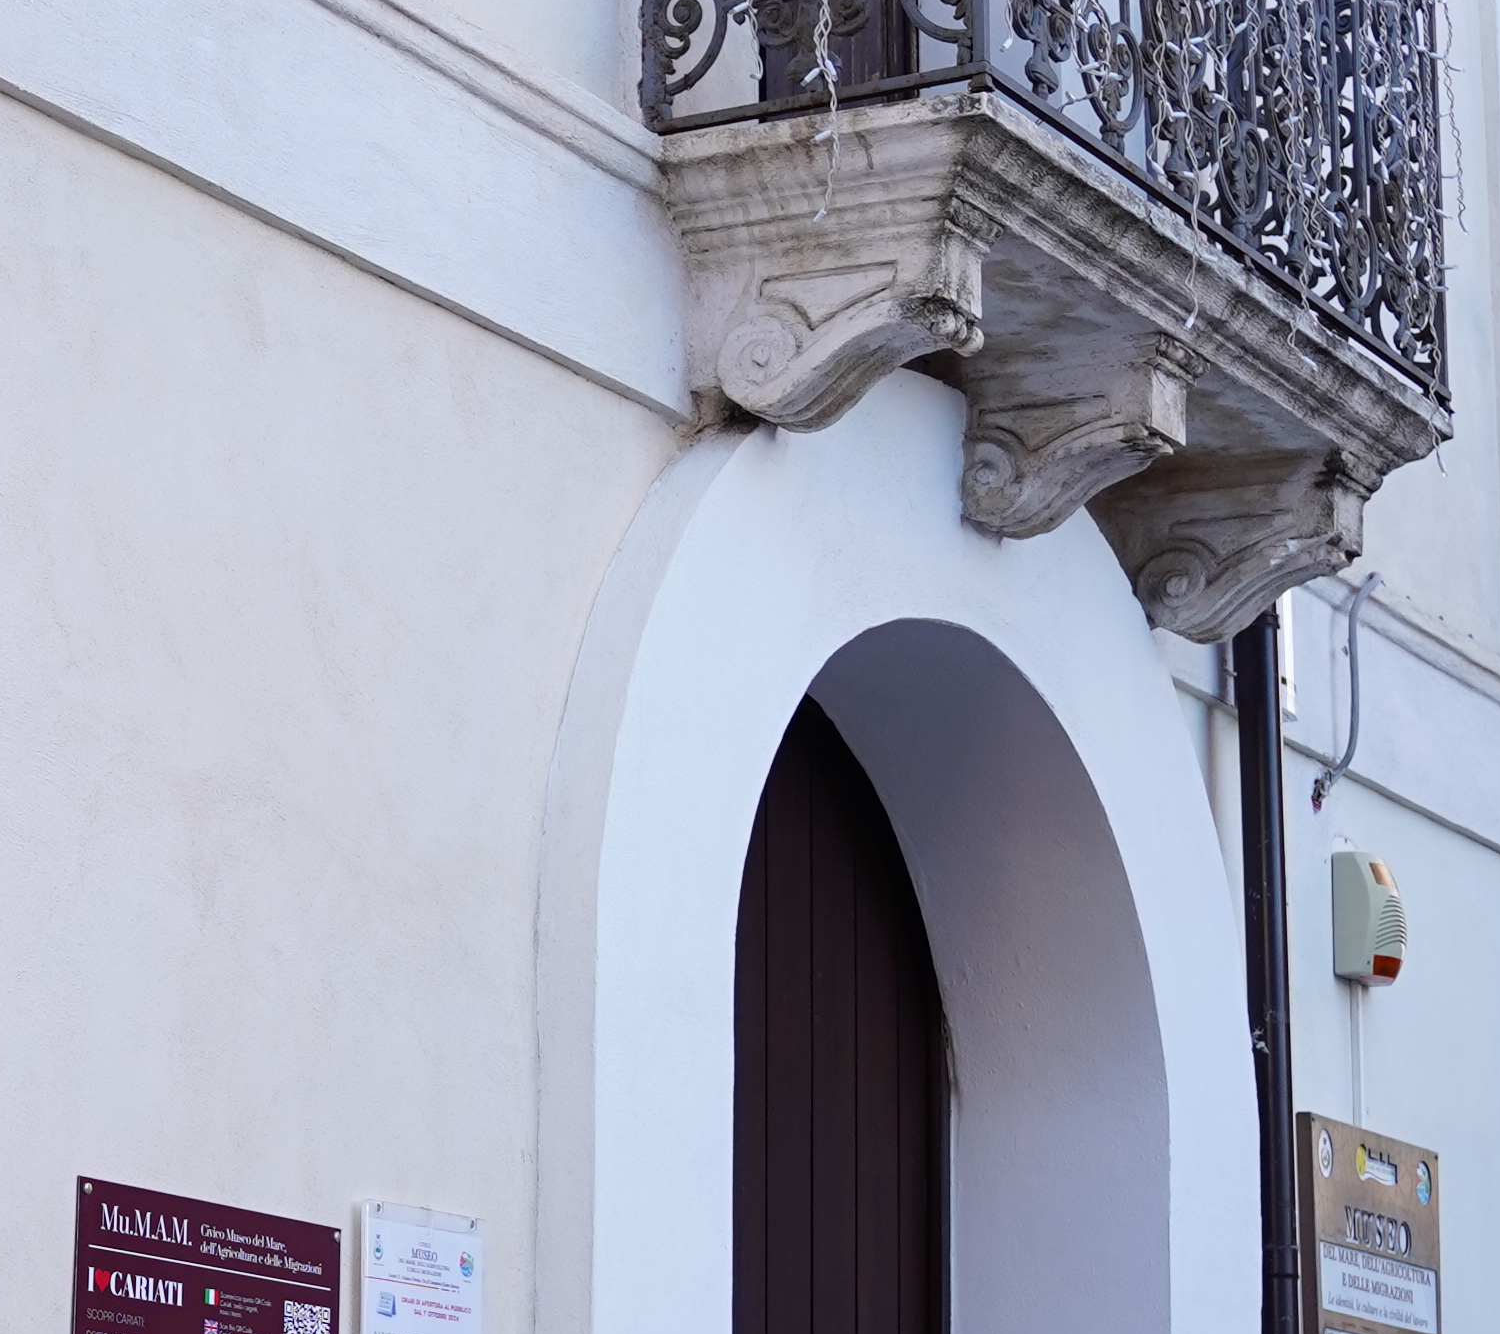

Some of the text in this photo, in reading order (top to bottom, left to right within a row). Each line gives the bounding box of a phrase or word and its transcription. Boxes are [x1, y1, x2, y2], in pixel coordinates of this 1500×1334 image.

[100, 1202, 193, 1246] Mu.M.A.M.
[200, 1223, 287, 1253] Civico Museo del Mare,
[1344, 1205, 1412, 1259] MUSEO
[258, 1255, 264, 1264] e
[264, 1253, 283, 1267] delle
[283, 1256, 322, 1275] Migrazioni
[411, 1248, 438, 1262] MUSEO
[1322, 1243, 1337, 1261] DEL
[109, 1270, 183, 1307] CARIATI
[1341, 1271, 1414, 1304] E DELLE MIGRAZIONI
[86, 1307, 115, 1322] SCOPRI
